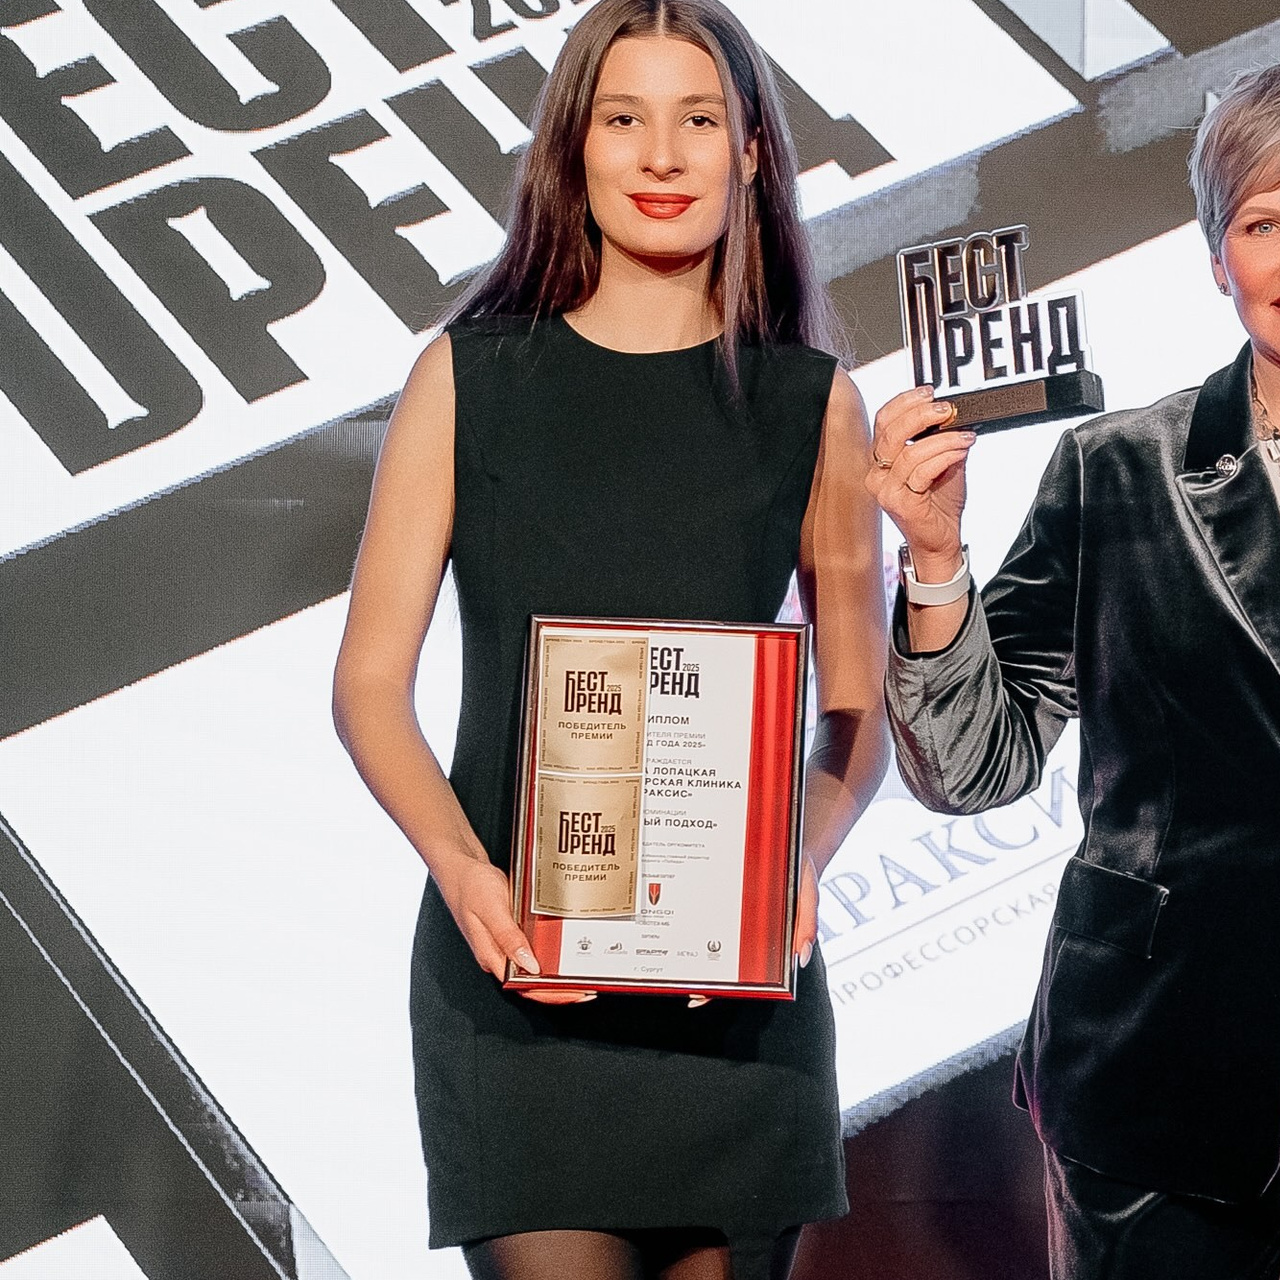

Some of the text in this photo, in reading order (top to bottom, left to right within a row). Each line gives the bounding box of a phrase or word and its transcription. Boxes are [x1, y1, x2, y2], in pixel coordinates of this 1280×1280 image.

[650, 646, 684, 671] ЕСТ
[682, 663, 700, 672] 2025
[649, 671, 700, 699] РЕНД
[647, 715, 690, 725] ИПЛОМ
[557, 721, 627, 731] ПОБЕДИТЕЛЬ
[570, 732, 614, 740] ПРЕМИИ
[655, 739, 680, 748] ГОДА
[646, 757, 692, 765] РАЖДАЕТСЯ
[653, 767, 717, 777] ЛОПАЦКАЯ
[644, 777, 683, 787] РСКАЯ
[687, 779, 742, 789] КЛИНИКА
[643, 808, 687, 817] ОМИНАЦИИ
[552, 862, 621, 872] ПОБЕДИТЕЛЬ
[564, 873, 607, 882] ПРЕМИИ
